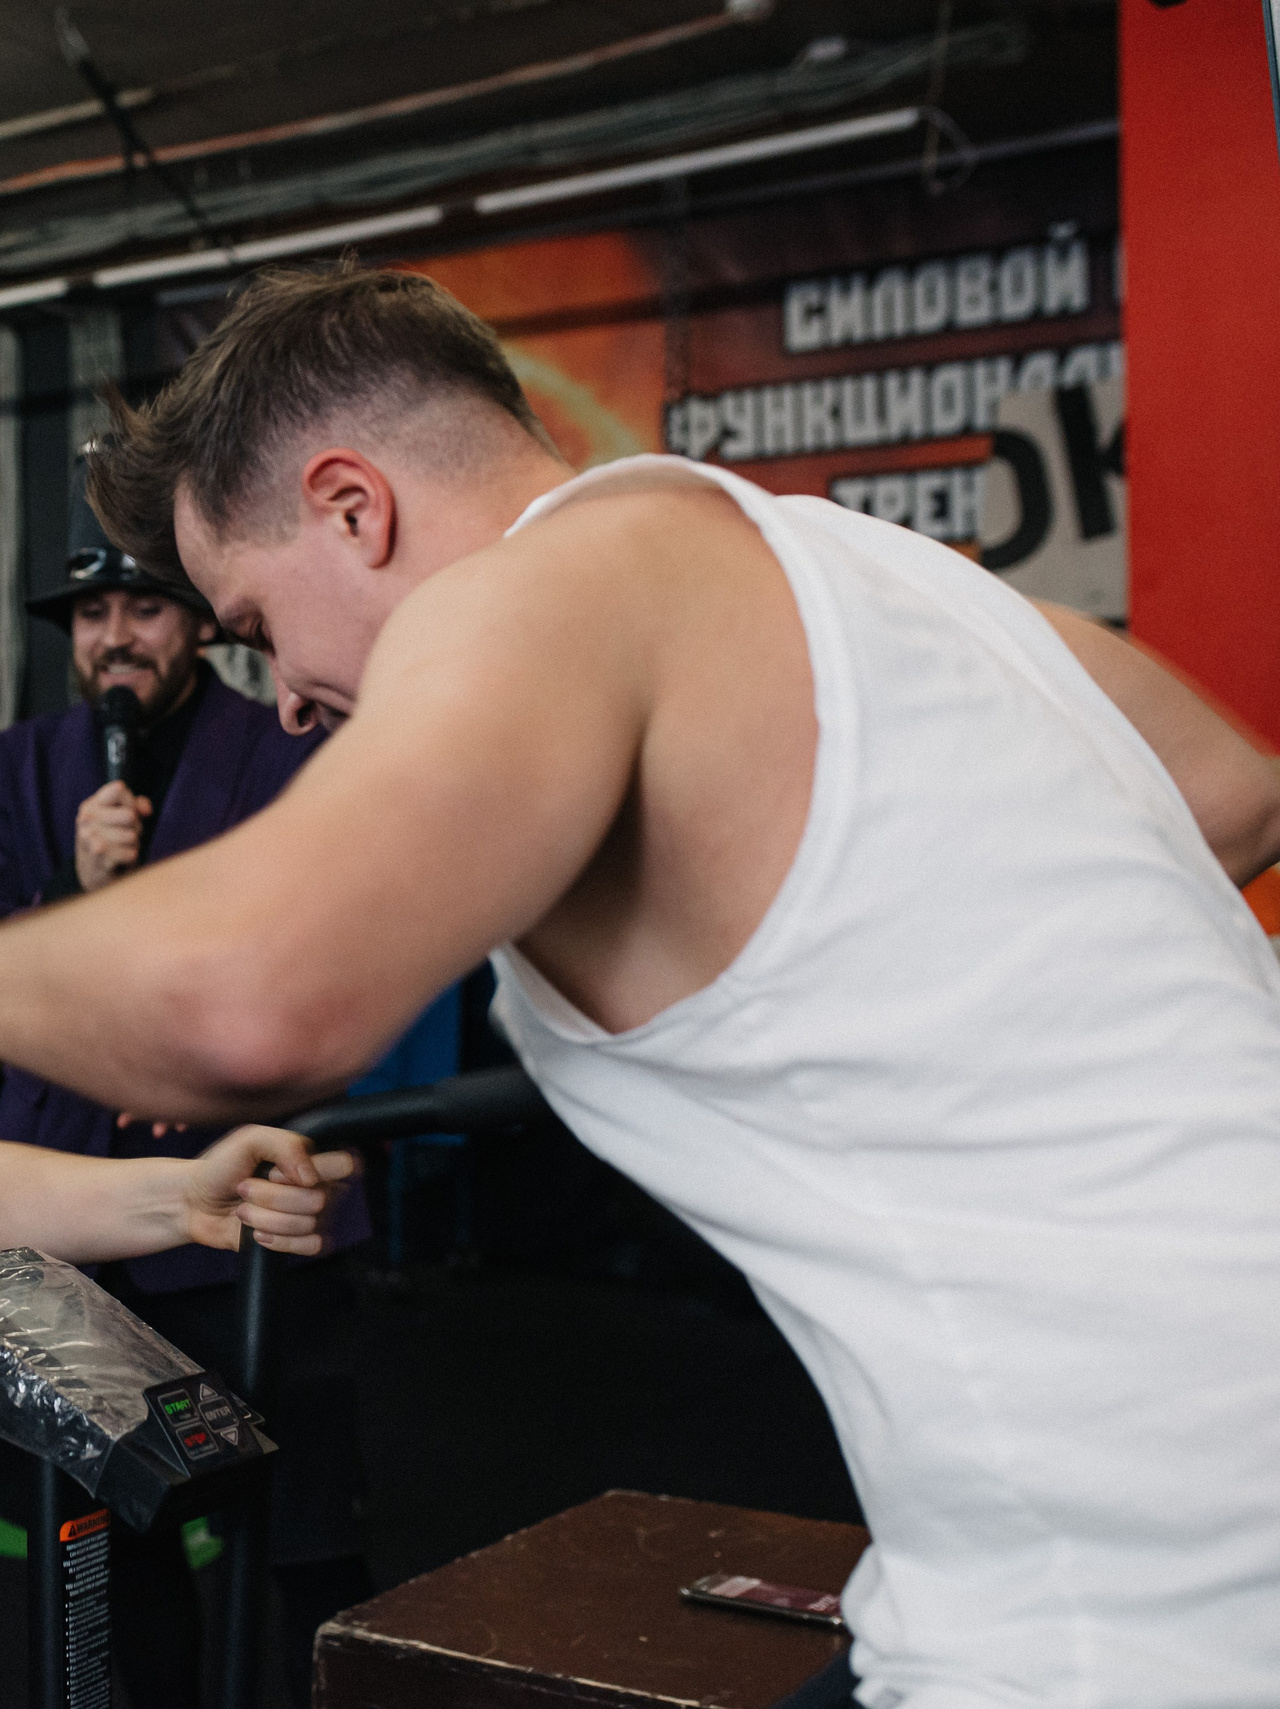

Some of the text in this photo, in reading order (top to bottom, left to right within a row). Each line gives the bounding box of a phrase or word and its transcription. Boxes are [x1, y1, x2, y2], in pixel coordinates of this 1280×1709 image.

[786, 222, 1087, 352] СИЛОВОЙ
[668, 341, 1124, 461] ФУНКЦИОН
[165, 1399, 190, 1414] START
